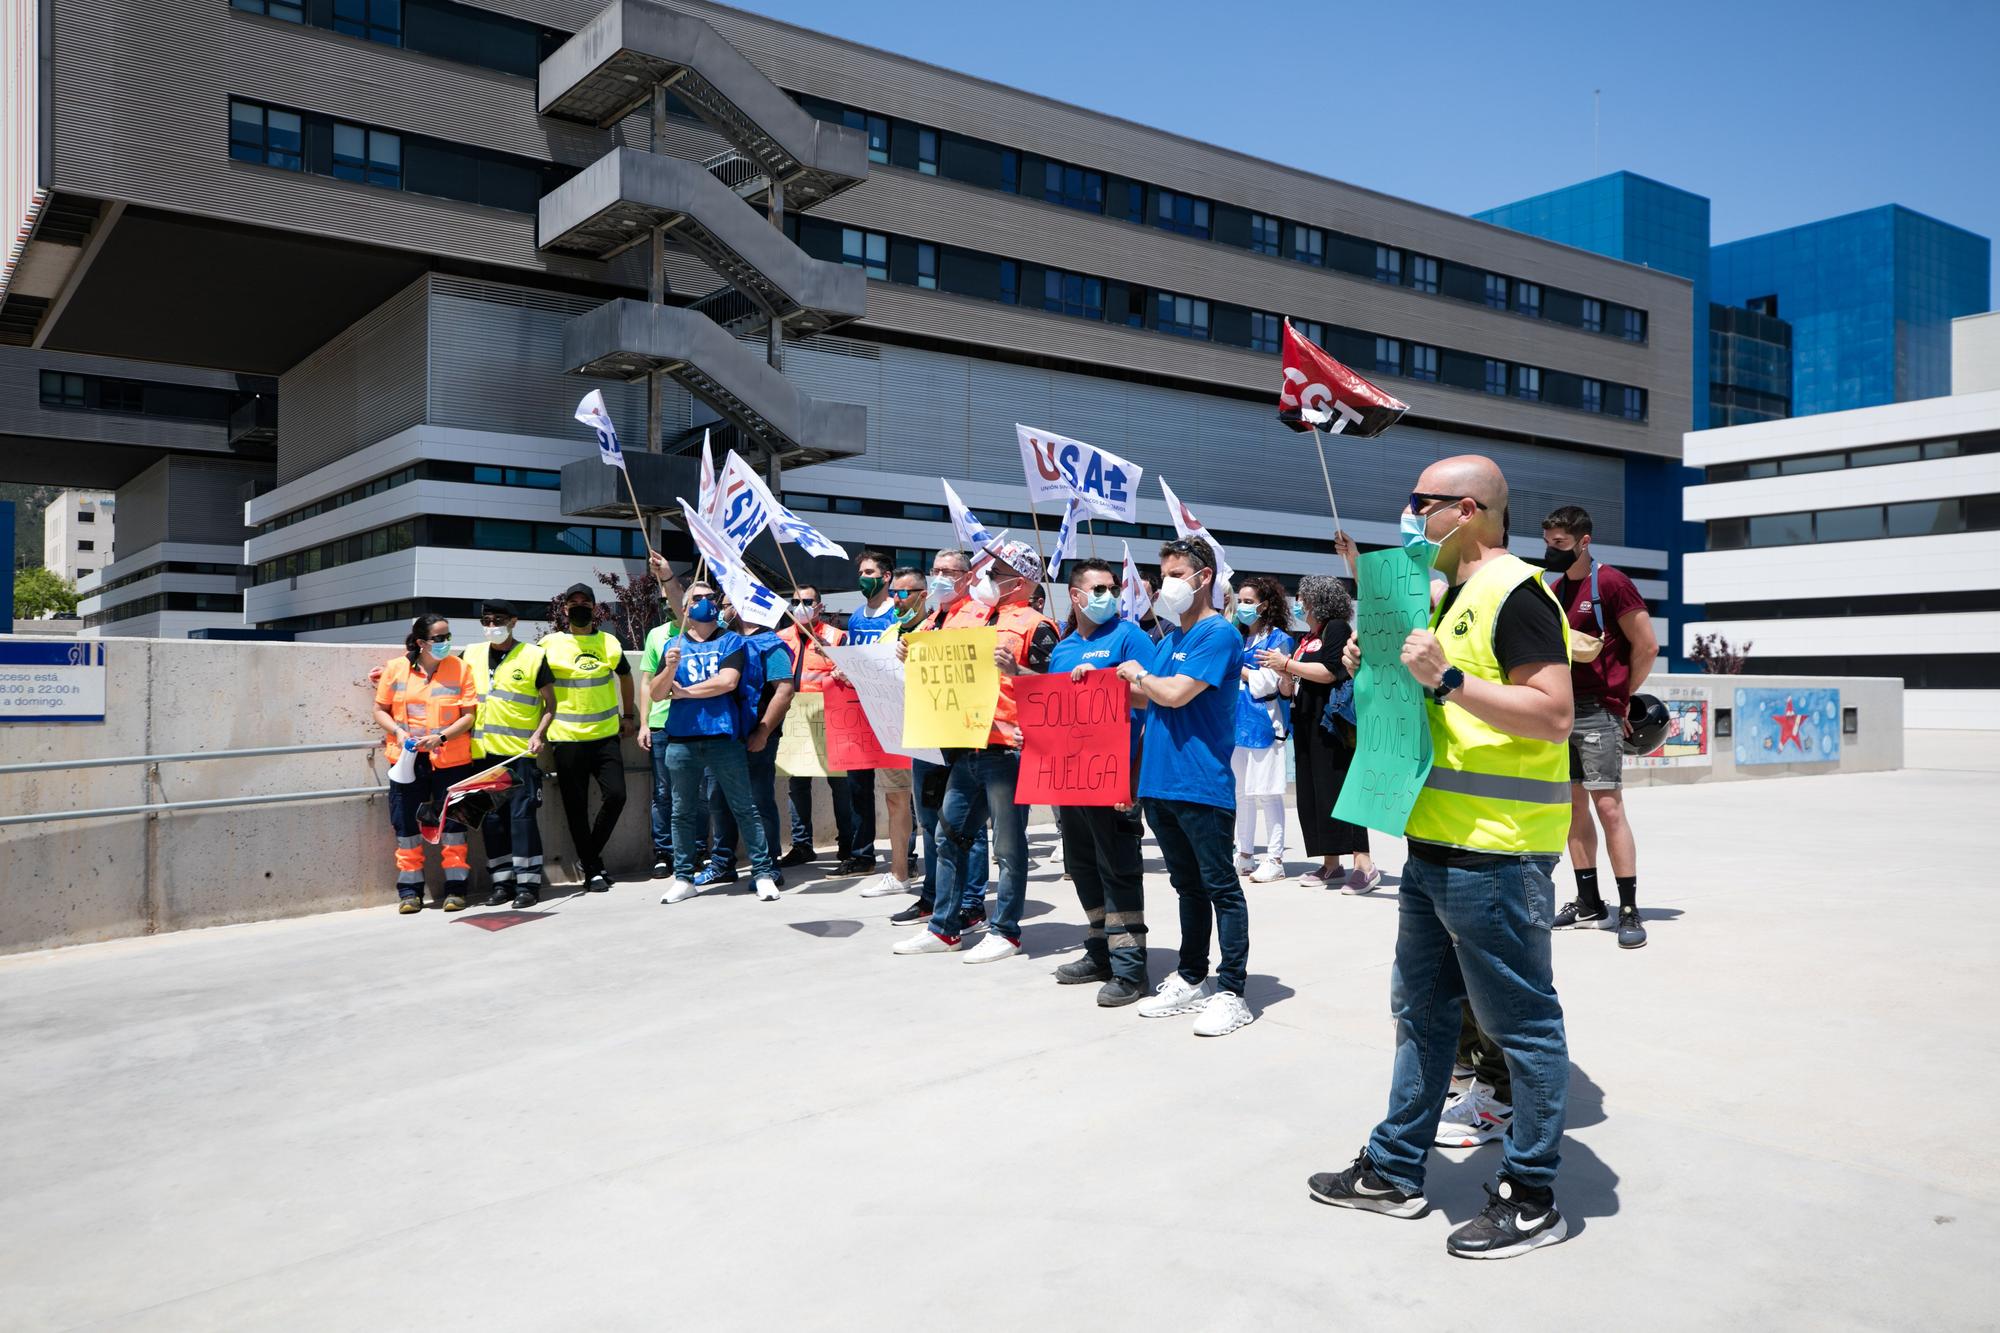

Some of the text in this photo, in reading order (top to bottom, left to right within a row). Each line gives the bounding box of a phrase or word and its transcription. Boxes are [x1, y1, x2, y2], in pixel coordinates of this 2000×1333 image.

[1281, 367, 1364, 434] CGT
[909, 644, 978, 663] CONVENIO
[34, 672, 58, 681] está
[920, 663, 976, 685] DIGNO
[38, 685, 70, 694] 22:00
[928, 687, 961, 711] YA
[1027, 673, 1119, 728] SOLUCIÓN
[1363, 714, 1382, 752] NO
[1384, 717, 1406, 758] ME
[1036, 754, 1118, 791] HUELGA
